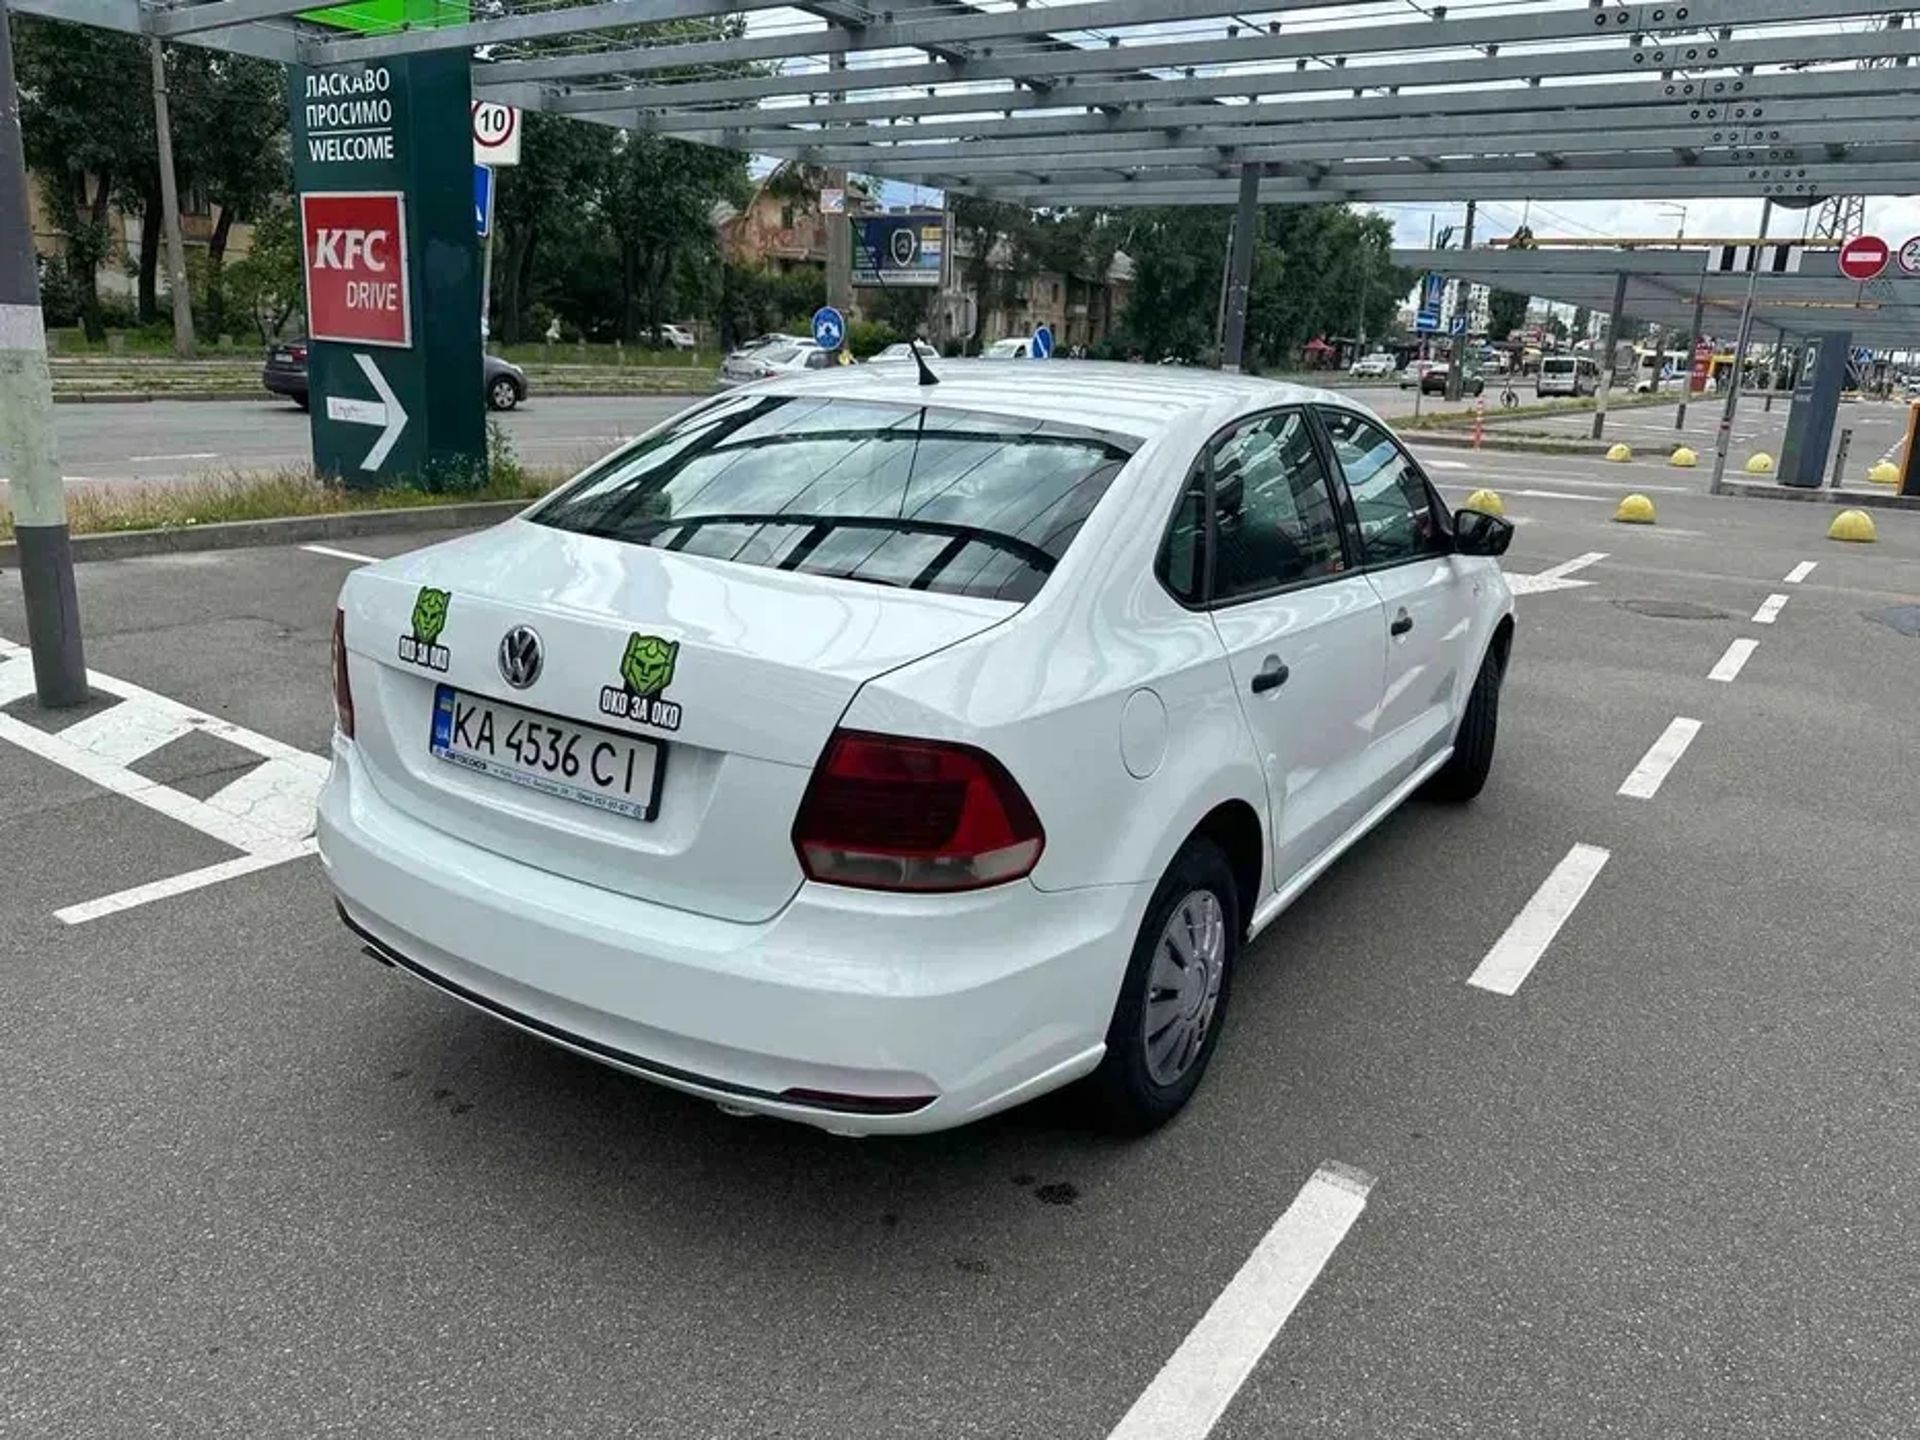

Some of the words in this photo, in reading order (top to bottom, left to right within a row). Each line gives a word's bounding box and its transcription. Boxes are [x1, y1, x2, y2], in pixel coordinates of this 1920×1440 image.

[306, 67, 390, 97] ЛАСКАВО
[306, 99, 392, 127] ПРОСИМО
[481, 109, 505, 132] 10
[308, 136, 394, 162] WELCOME
[313, 228, 387, 272] KFC
[346, 281, 398, 310] DRIVE
[1803, 347, 1816, 381] P
[453, 702, 495, 755] KA
[505, 719, 582, 777] 4536
[590, 742, 636, 794] CI
